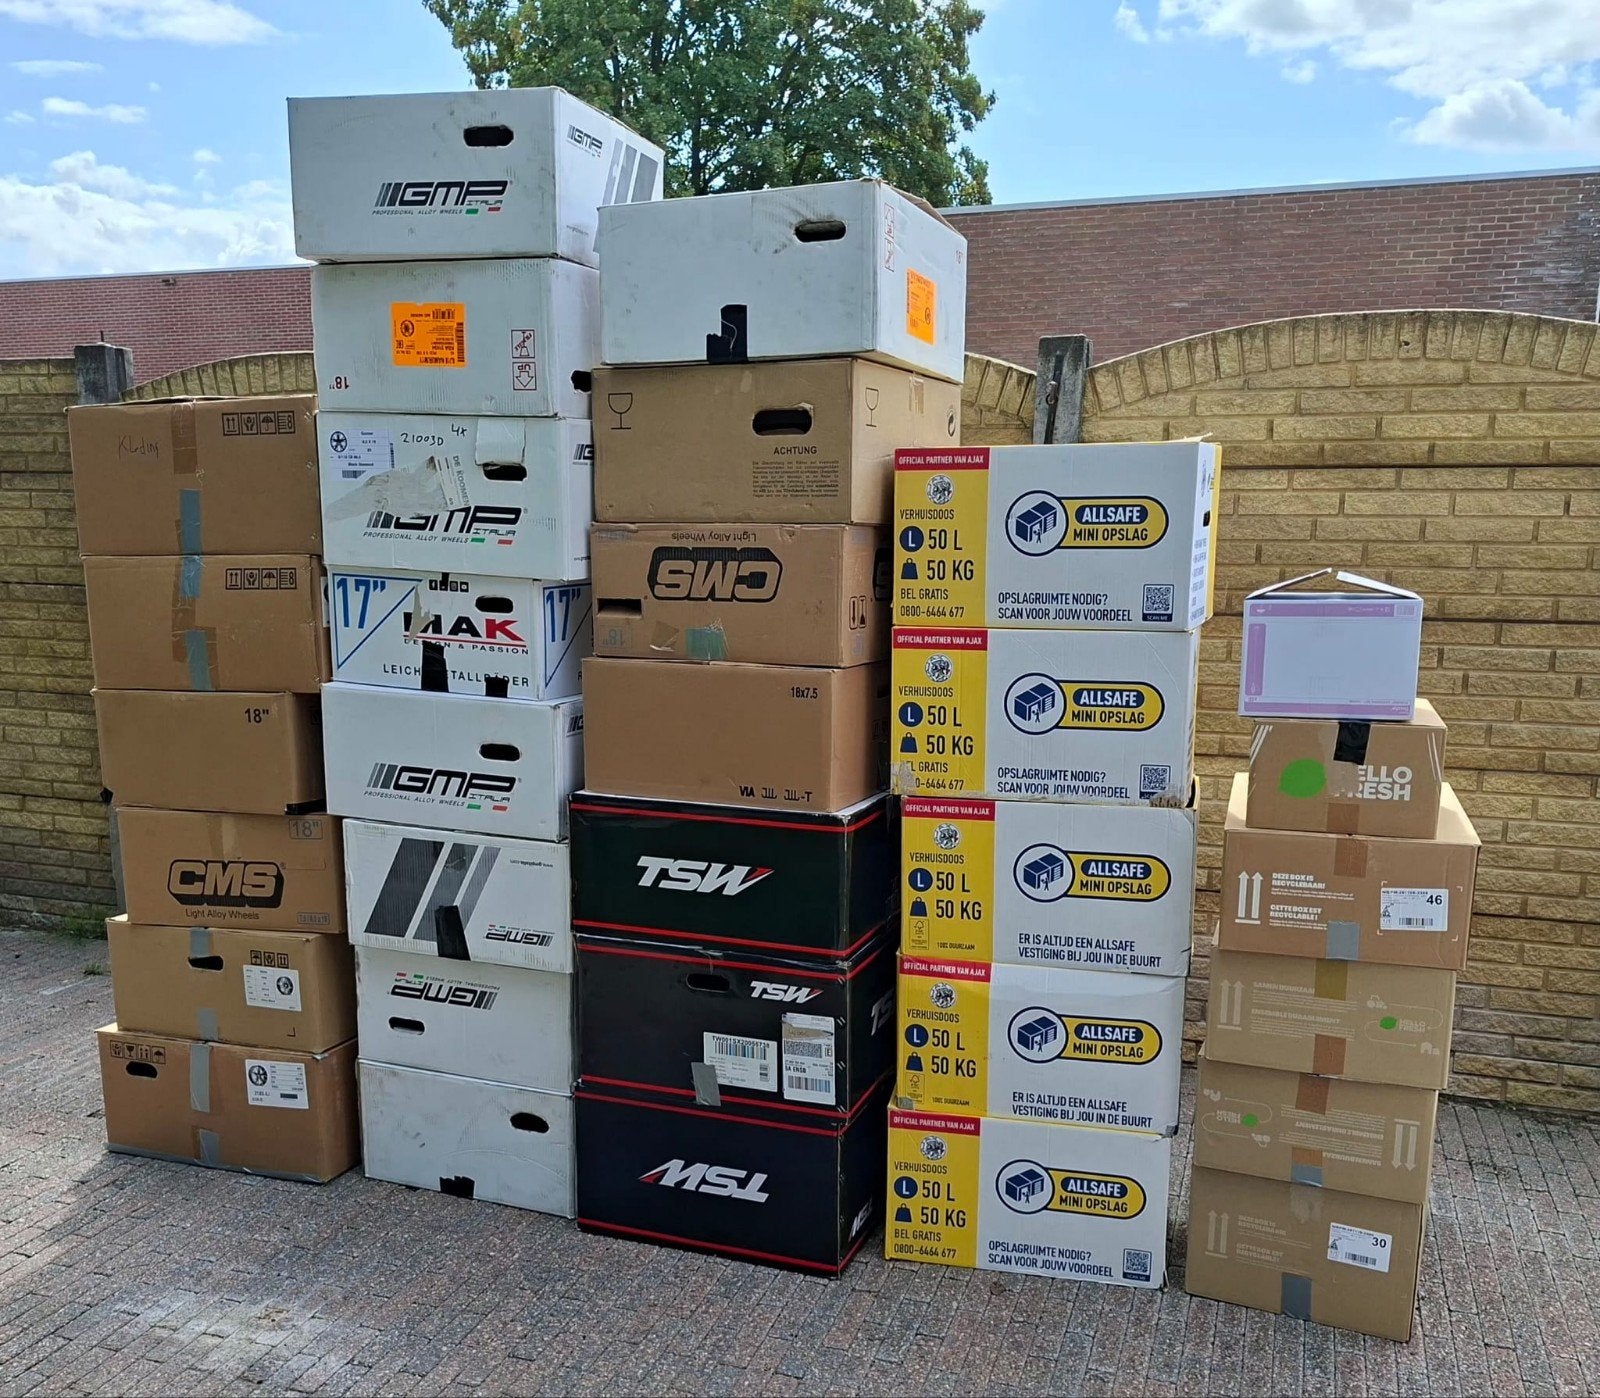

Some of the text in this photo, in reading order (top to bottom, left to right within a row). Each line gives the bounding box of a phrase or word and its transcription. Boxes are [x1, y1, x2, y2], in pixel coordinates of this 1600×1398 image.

[400, 180, 508, 206] GMP
[774, 446, 817, 455] ACHTUNG
[898, 456, 924, 465] OFFICIAL
[926, 456, 952, 464] PARTNER
[968, 455, 984, 463] AJAX
[899, 508, 954, 520] VERHUISDOOS
[1081, 507, 1141, 523] ALLSAFE
[363, 531, 413, 540] PROFESSIONAL
[672, 532, 757, 543] Light Alloy Wheels
[928, 529, 948, 550] 50
[1073, 526, 1148, 542] MINI OPSLAG
[647, 547, 782, 602] CMS
[927, 560, 974, 581] 50 KG
[900, 588, 948, 600] BEL GRATIS
[998, 592, 1108, 606] OPSLAGRUIMTE NODIG?
[900, 606, 964, 618] 0800-6464 677
[998, 607, 1132, 622] SCAN VOOR JOUW VOORDEEL
[897, 635, 982, 645] OFFICIAL PARTNER VAN AJAX
[472, 645, 529, 654] PASSION
[791, 686, 818, 699] 18x7.5
[898, 686, 953, 698] VERHUISDOOS
[1080, 691, 1138, 706] ALLSAFE
[244, 708, 269, 723] 18"
[928, 706, 948, 726] 50
[1072, 710, 1145, 724] MINI OPSLAG
[926, 735, 974, 756] 50 KG
[919, 761, 948, 772] GRATIS
[393, 765, 516, 798] GMP
[998, 767, 1106, 783] OPSLAGRUIMTE NODIG?
[1358, 765, 1412, 784] ELLO
[739, 786, 755, 797] VIA
[949, 779, 964, 790] 677
[997, 781, 1021, 794] SCAN
[1022, 782, 1048, 795] VOOR
[1053, 784, 1079, 796] JOUW
[1080, 785, 1130, 799] VOORDEEL
[364, 791, 411, 801] PROFESSIONAL
[906, 804, 990, 815] OFFICIAL PARTNER VAN AJAX
[291, 821, 319, 838] 18"
[909, 852, 964, 864] VERHUISDOOS
[637, 856, 774, 896] TSW
[1088, 863, 1144, 878] ALLSAFE
[168, 860, 284, 906] CMS
[936, 872, 955, 891] 50
[1080, 880, 1152, 895] MINI OPSLAG
[1426, 894, 1442, 905] 46
[186, 909, 259, 920] Light Alloy Wheels
[935, 900, 982, 920] 50 KG
[485, 930, 541, 946] GMP
[1018, 933, 1135, 952] ER IS ALTIJD EEN ALLSAFE
[1018, 947, 1161, 967] VESTIGING BIJ JOU IN DE BUURT
[904, 962, 985, 977] OFFICIAL PARTNER VAN AJAX
[391, 982, 478, 1007] GMP
[750, 981, 823, 1003] TSW
[907, 1009, 960, 1023] VERHUISDOOS
[932, 1030, 950, 1048] 50
[1082, 1027, 1136, 1042] ALLSAFE
[1073, 1043, 1144, 1058] MINI OPSLAG
[931, 1056, 976, 1078] 50 KG
[1012, 1092, 1127, 1112] ER IS ALTIJD EEN ALLSAFE
[894, 1116, 975, 1131] OFFICIAL PARTNER VAN AJAX
[1012, 1104, 1152, 1128] VESTIGING BIJ JOU IN DE BUURT
[894, 1161, 947, 1175] VERHUISDOOS
[638, 1159, 770, 1203] TSW
[1067, 1178, 1121, 1197] ALLSAFE
[922, 1180, 941, 1198] 50
[1059, 1195, 1128, 1213] MINI OPSLAG
[920, 1207, 966, 1228] 50 KG
[894, 1229, 942, 1242] BEL GRATIS
[1371, 1237, 1386, 1248] 30
[894, 1244, 956, 1259] 0800-6464 677
[988, 1240, 1091, 1261] OPSLAGRUIMTE NODIG?
[988, 1253, 1113, 1278] SCAN VOOR JOUW VOORDEEL
